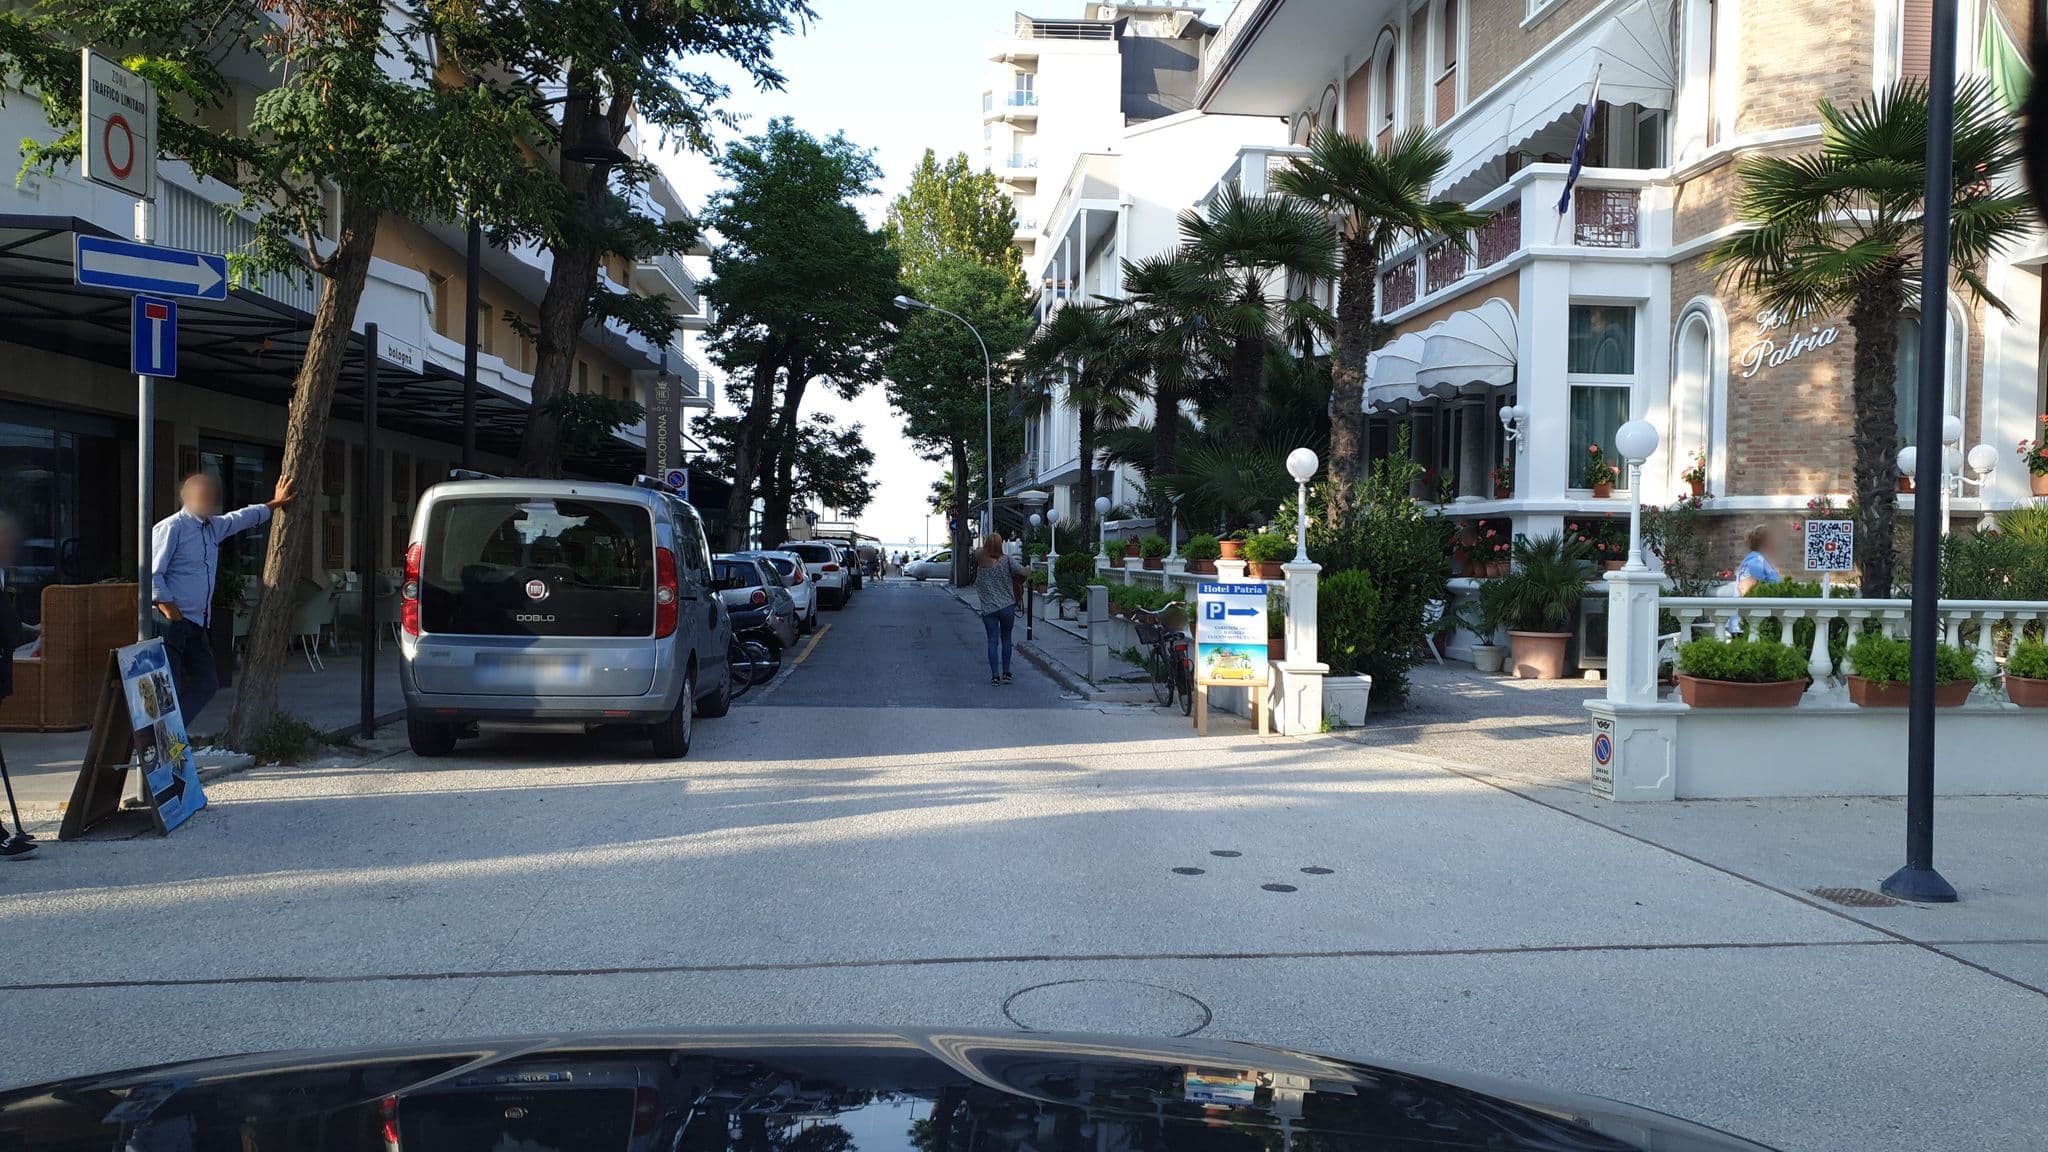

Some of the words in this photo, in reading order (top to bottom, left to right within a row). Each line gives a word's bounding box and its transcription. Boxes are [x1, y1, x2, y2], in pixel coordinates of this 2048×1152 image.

[111, 69, 128, 89] ZONA
[92, 79, 120, 103] TRAFFICO
[121, 92, 145, 115] LIMITATO
[388, 343, 412, 367] bologna
[1740, 326, 1840, 378] Patria
[1203, 584, 1230, 594] Hotel
[1234, 585, 1263, 594] Patria
[516, 614, 556, 622] DOBLO
[1209, 602, 1222, 619] P
